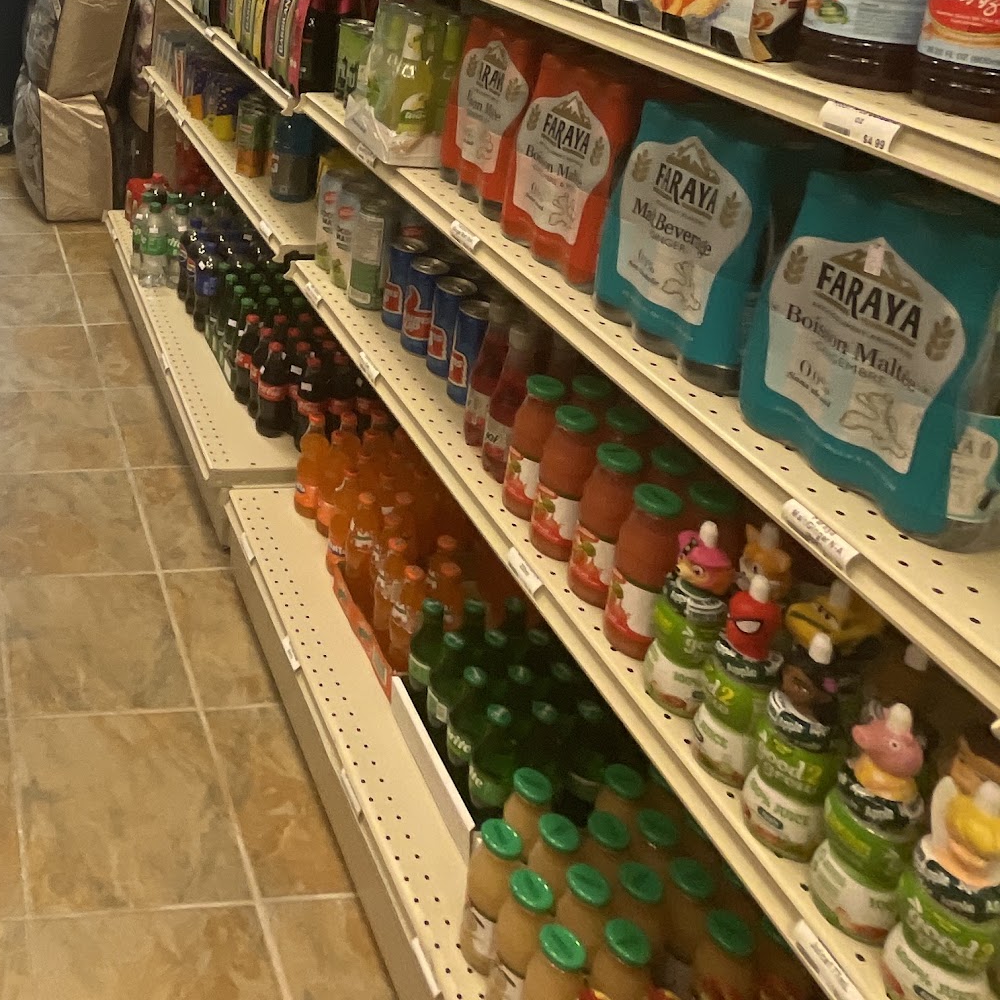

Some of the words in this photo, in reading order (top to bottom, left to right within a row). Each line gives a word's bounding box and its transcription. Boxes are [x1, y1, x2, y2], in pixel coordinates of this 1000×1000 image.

[542, 112, 592, 155] FARAYA
[655, 162, 720, 215] FARAYA
[816, 261, 923, 340] FARAYA
